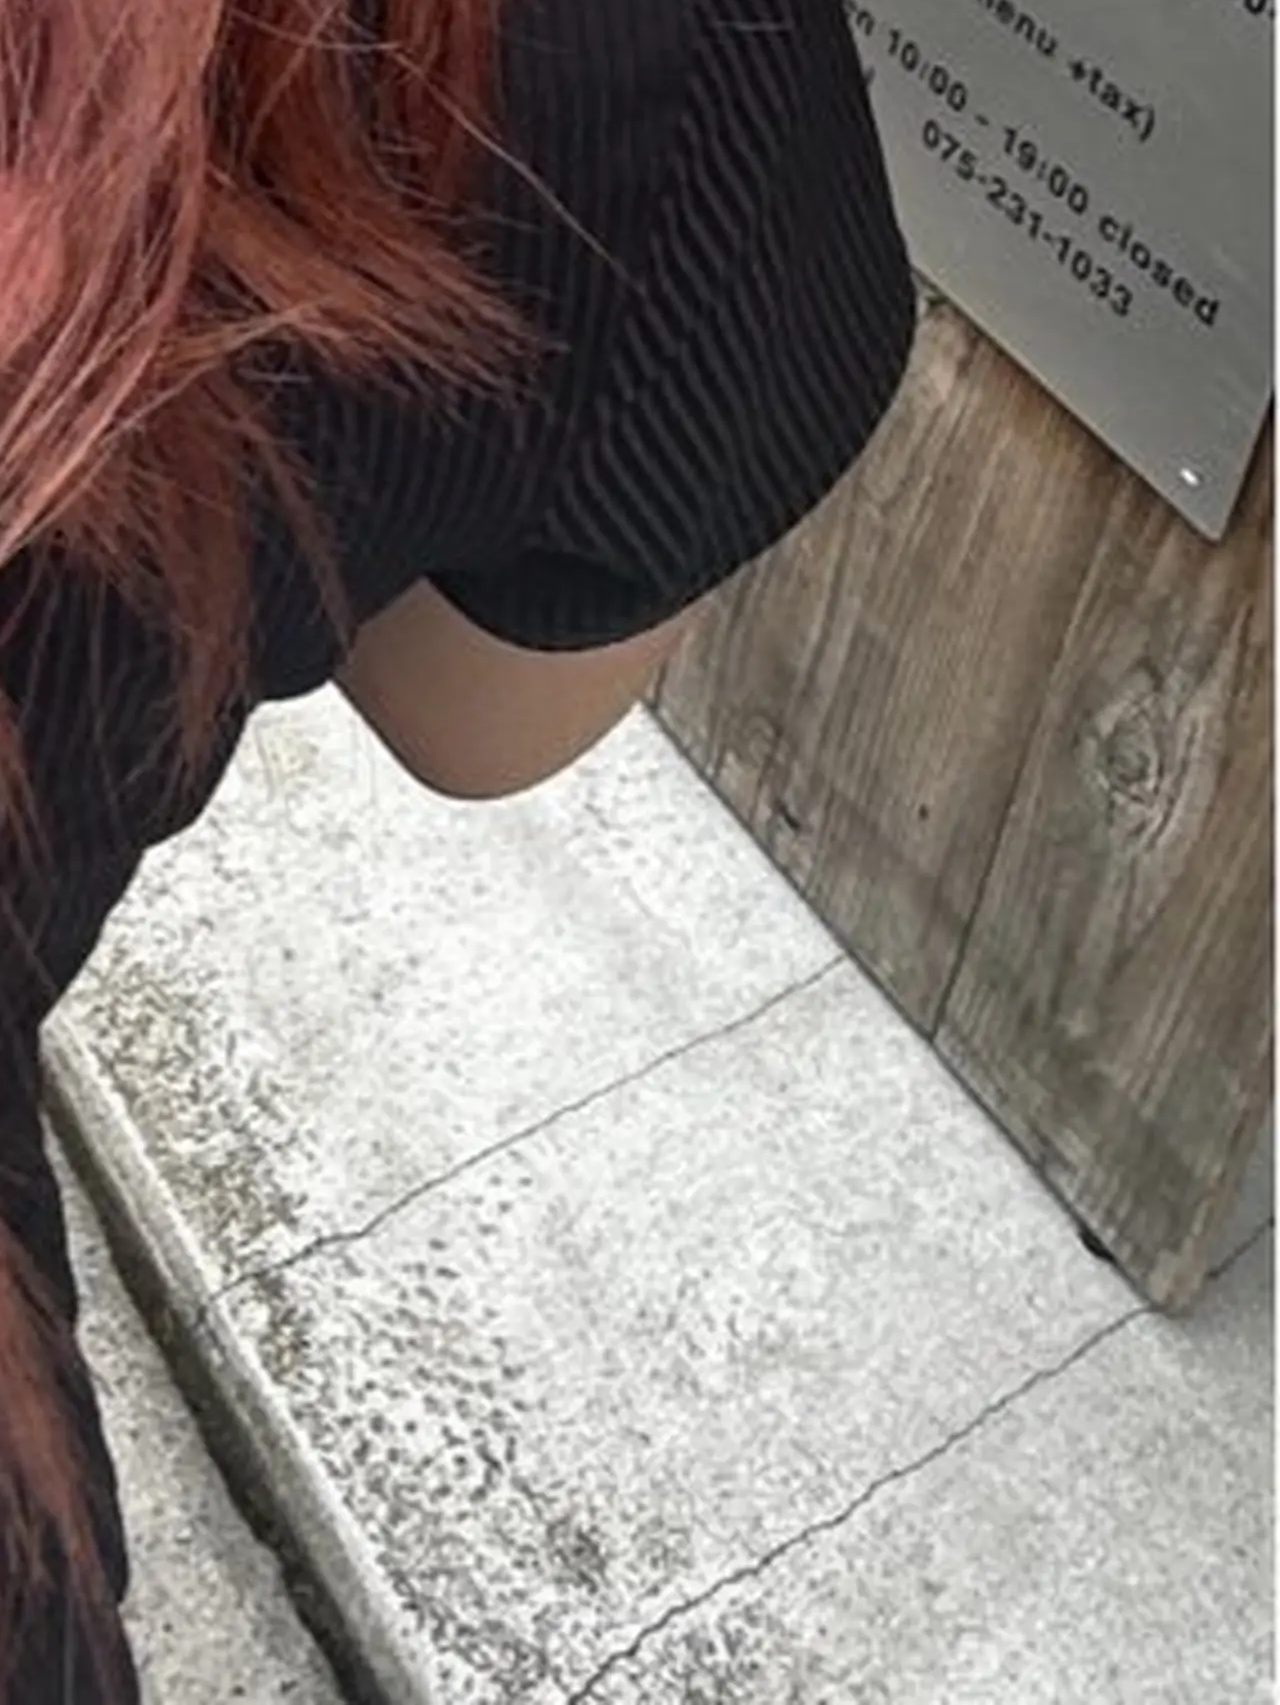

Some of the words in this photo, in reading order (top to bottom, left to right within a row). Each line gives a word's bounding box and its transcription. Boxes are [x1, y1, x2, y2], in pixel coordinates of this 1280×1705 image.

[888, 29, 967, 112] 10:00
[1004, 126, 1088, 215] 19:00
[1098, 216, 1220, 327] closed
[1069, 59, 1155, 143] +tax)
[923, 119, 1133, 317] 075-231-1033
